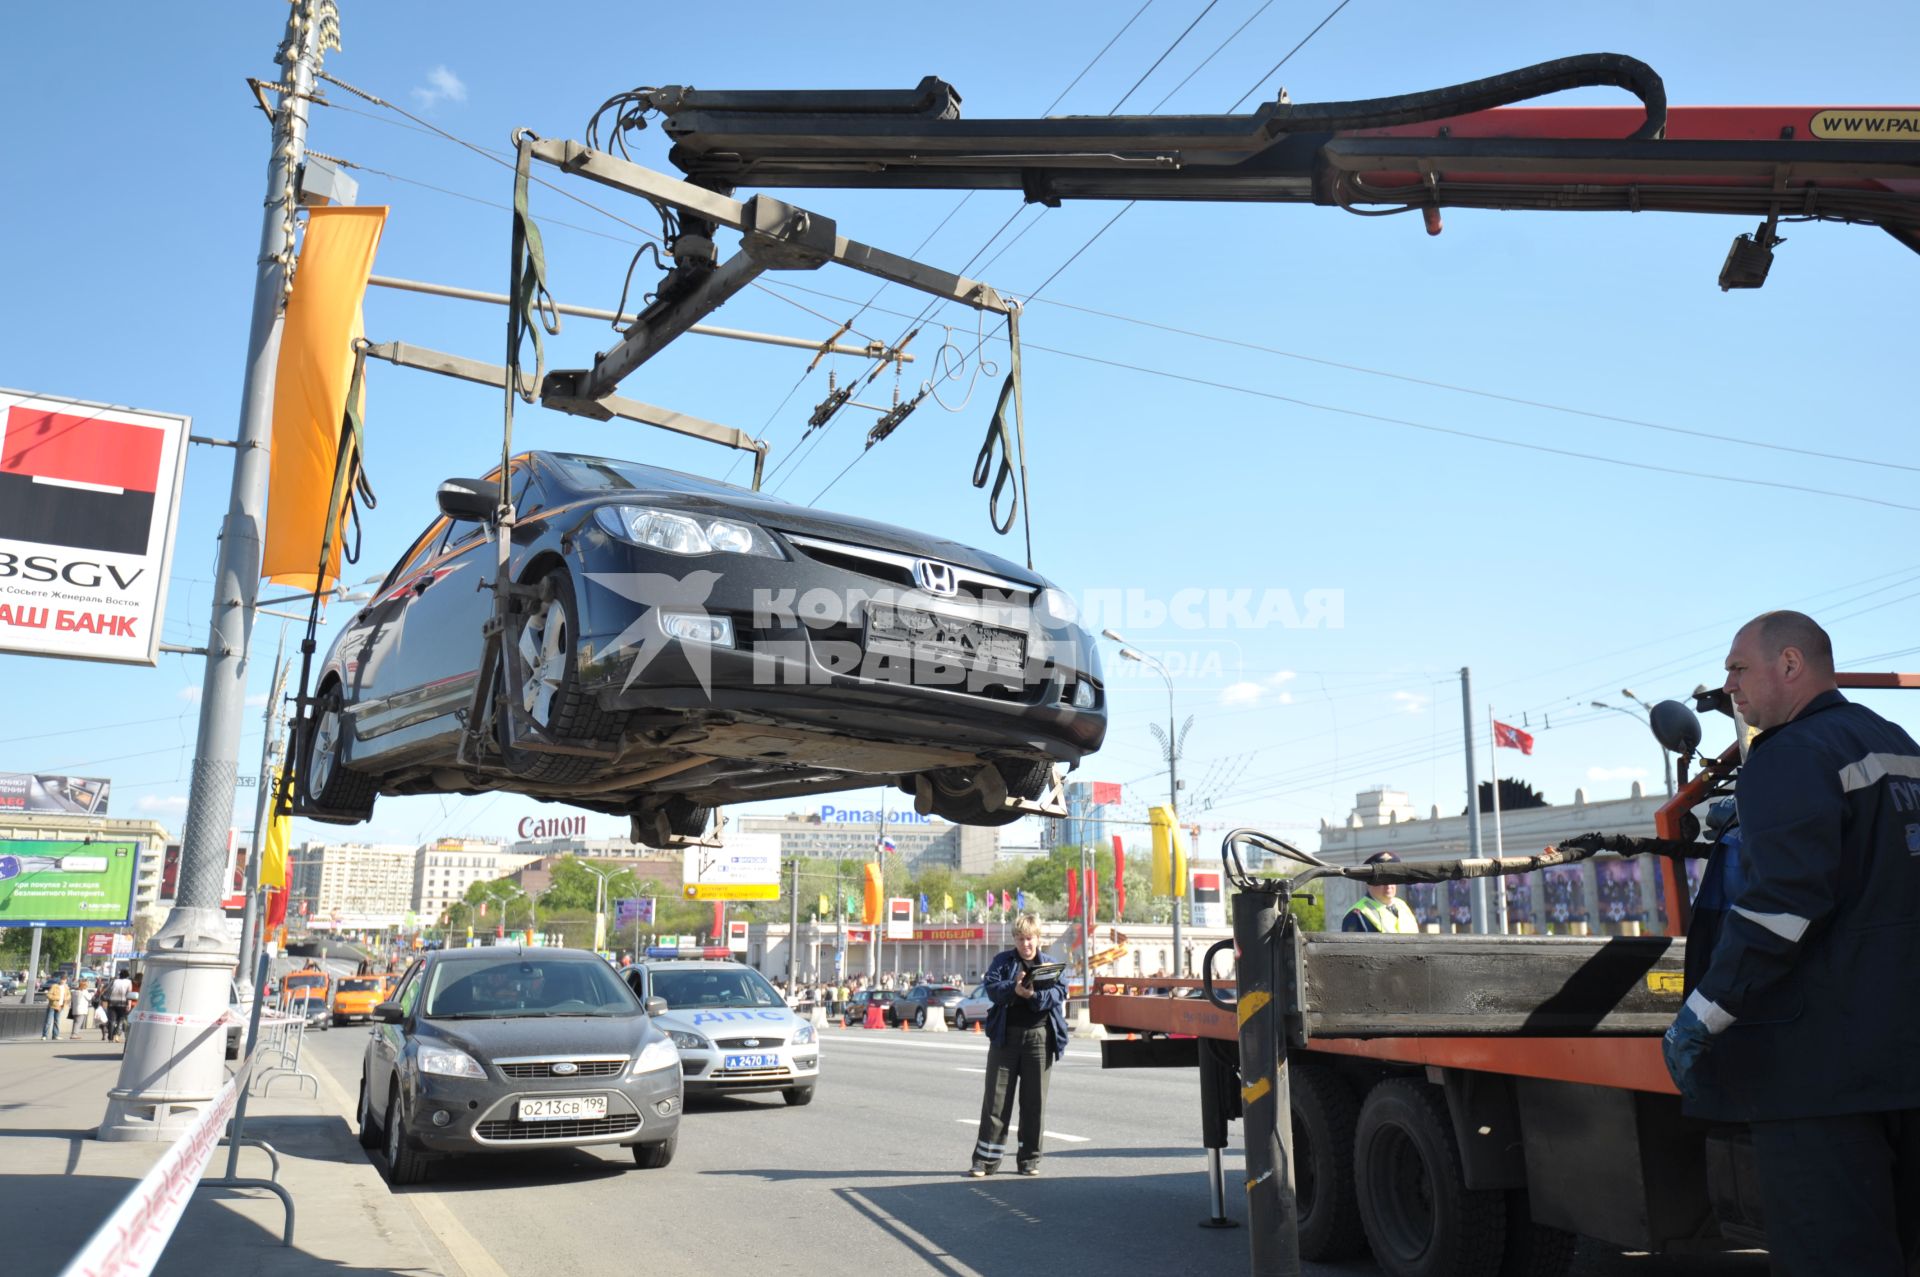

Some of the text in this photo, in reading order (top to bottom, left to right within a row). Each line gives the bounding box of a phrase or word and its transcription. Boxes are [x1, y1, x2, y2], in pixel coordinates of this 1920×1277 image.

[7, 585, 48, 598] Сосьете
[51, 590, 103, 603] Женераль
[105, 596, 140, 607] Восток
[55, 609, 138, 638] БАНК
[821, 805, 930, 824] Panasonic
[518, 816, 586, 839] Canon
[931, 930, 975, 939] ПОБЕДА
[694, 1011, 785, 1025] ДПС
[739, 1056, 762, 1066] 2470
[584, 1098, 604, 1109] 199
